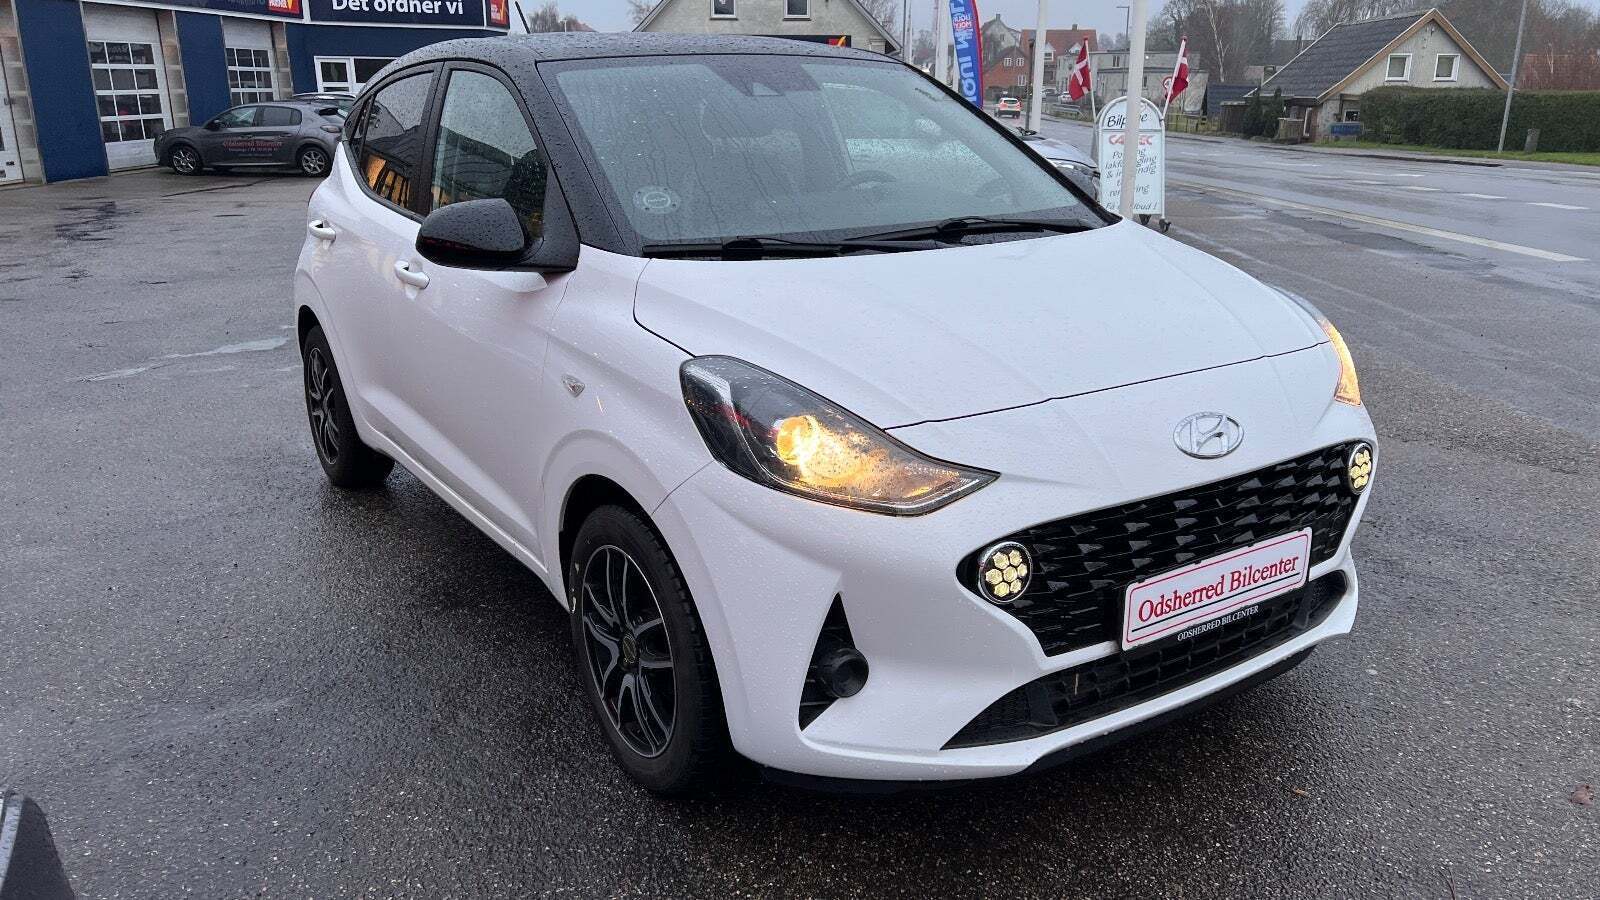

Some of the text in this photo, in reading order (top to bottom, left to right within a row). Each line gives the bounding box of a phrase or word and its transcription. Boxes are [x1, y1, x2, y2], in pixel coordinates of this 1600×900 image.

[332, 0, 463, 15] Det ordner vi
[1138, 556, 1299, 622] Odsherred Bilcenter
[1177, 605, 1259, 642] ODSHERRED BILCENTER
